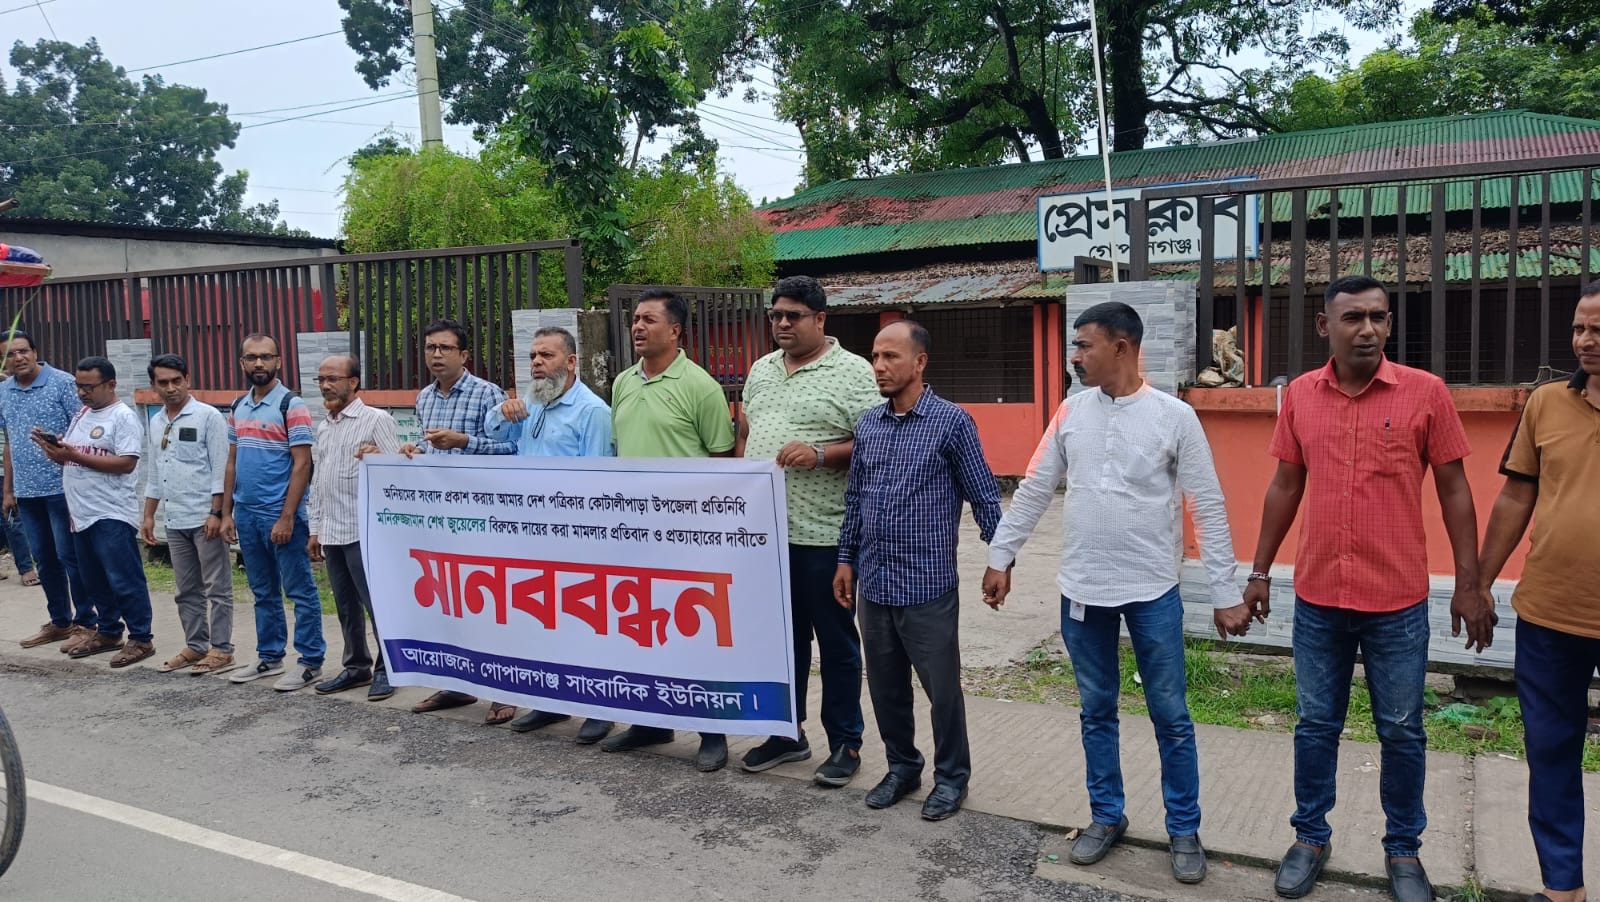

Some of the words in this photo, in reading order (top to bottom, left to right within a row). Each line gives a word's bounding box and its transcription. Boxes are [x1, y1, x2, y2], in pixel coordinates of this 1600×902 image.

[1044, 195, 1135, 242] প্রেস
[1088, 238, 1192, 258] গোপগঞ্জ
[383, 484, 415, 502] অনিয়মের
[418, 489, 442, 504] সংবাদ
[444, 490, 470, 505] প্রকাশ
[472, 492, 494, 506] করায়
[497, 493, 523, 508] আমার
[527, 494, 545, 509] দেশ
[549, 491, 585, 511] পত্রিকার
[588, 492, 648, 515] কোটালীপাড়া
[651, 494, 698, 515] উপজেলা
[701, 495, 747, 516] প্রতিনিধি
[376, 508, 424, 526] মনিরুজ্জামান
[427, 514, 444, 529] শেখ
[447, 516, 486, 534] জুয়েলের
[489, 515, 519, 535] বিরুদ্ধে
[522, 521, 548, 537] দায়ের
[551, 523, 569, 538] করা
[571, 523, 607, 541] মামলার
[610, 522, 650, 543] প্রতিবাদ
[652, 529, 662, 542] ও
[665, 529, 722, 547] প্রত্যাহারের
[725, 527, 768, 548] দাবীতে
[409, 548, 733, 648] মানববন্ধন
[401, 647, 475, 674] আয়োজনে:
[480, 662, 560, 690] গোপালগঞ্জ
[565, 674, 650, 702] সাংবাদিক
[654, 679, 743, 711] ইউনিয়ন
